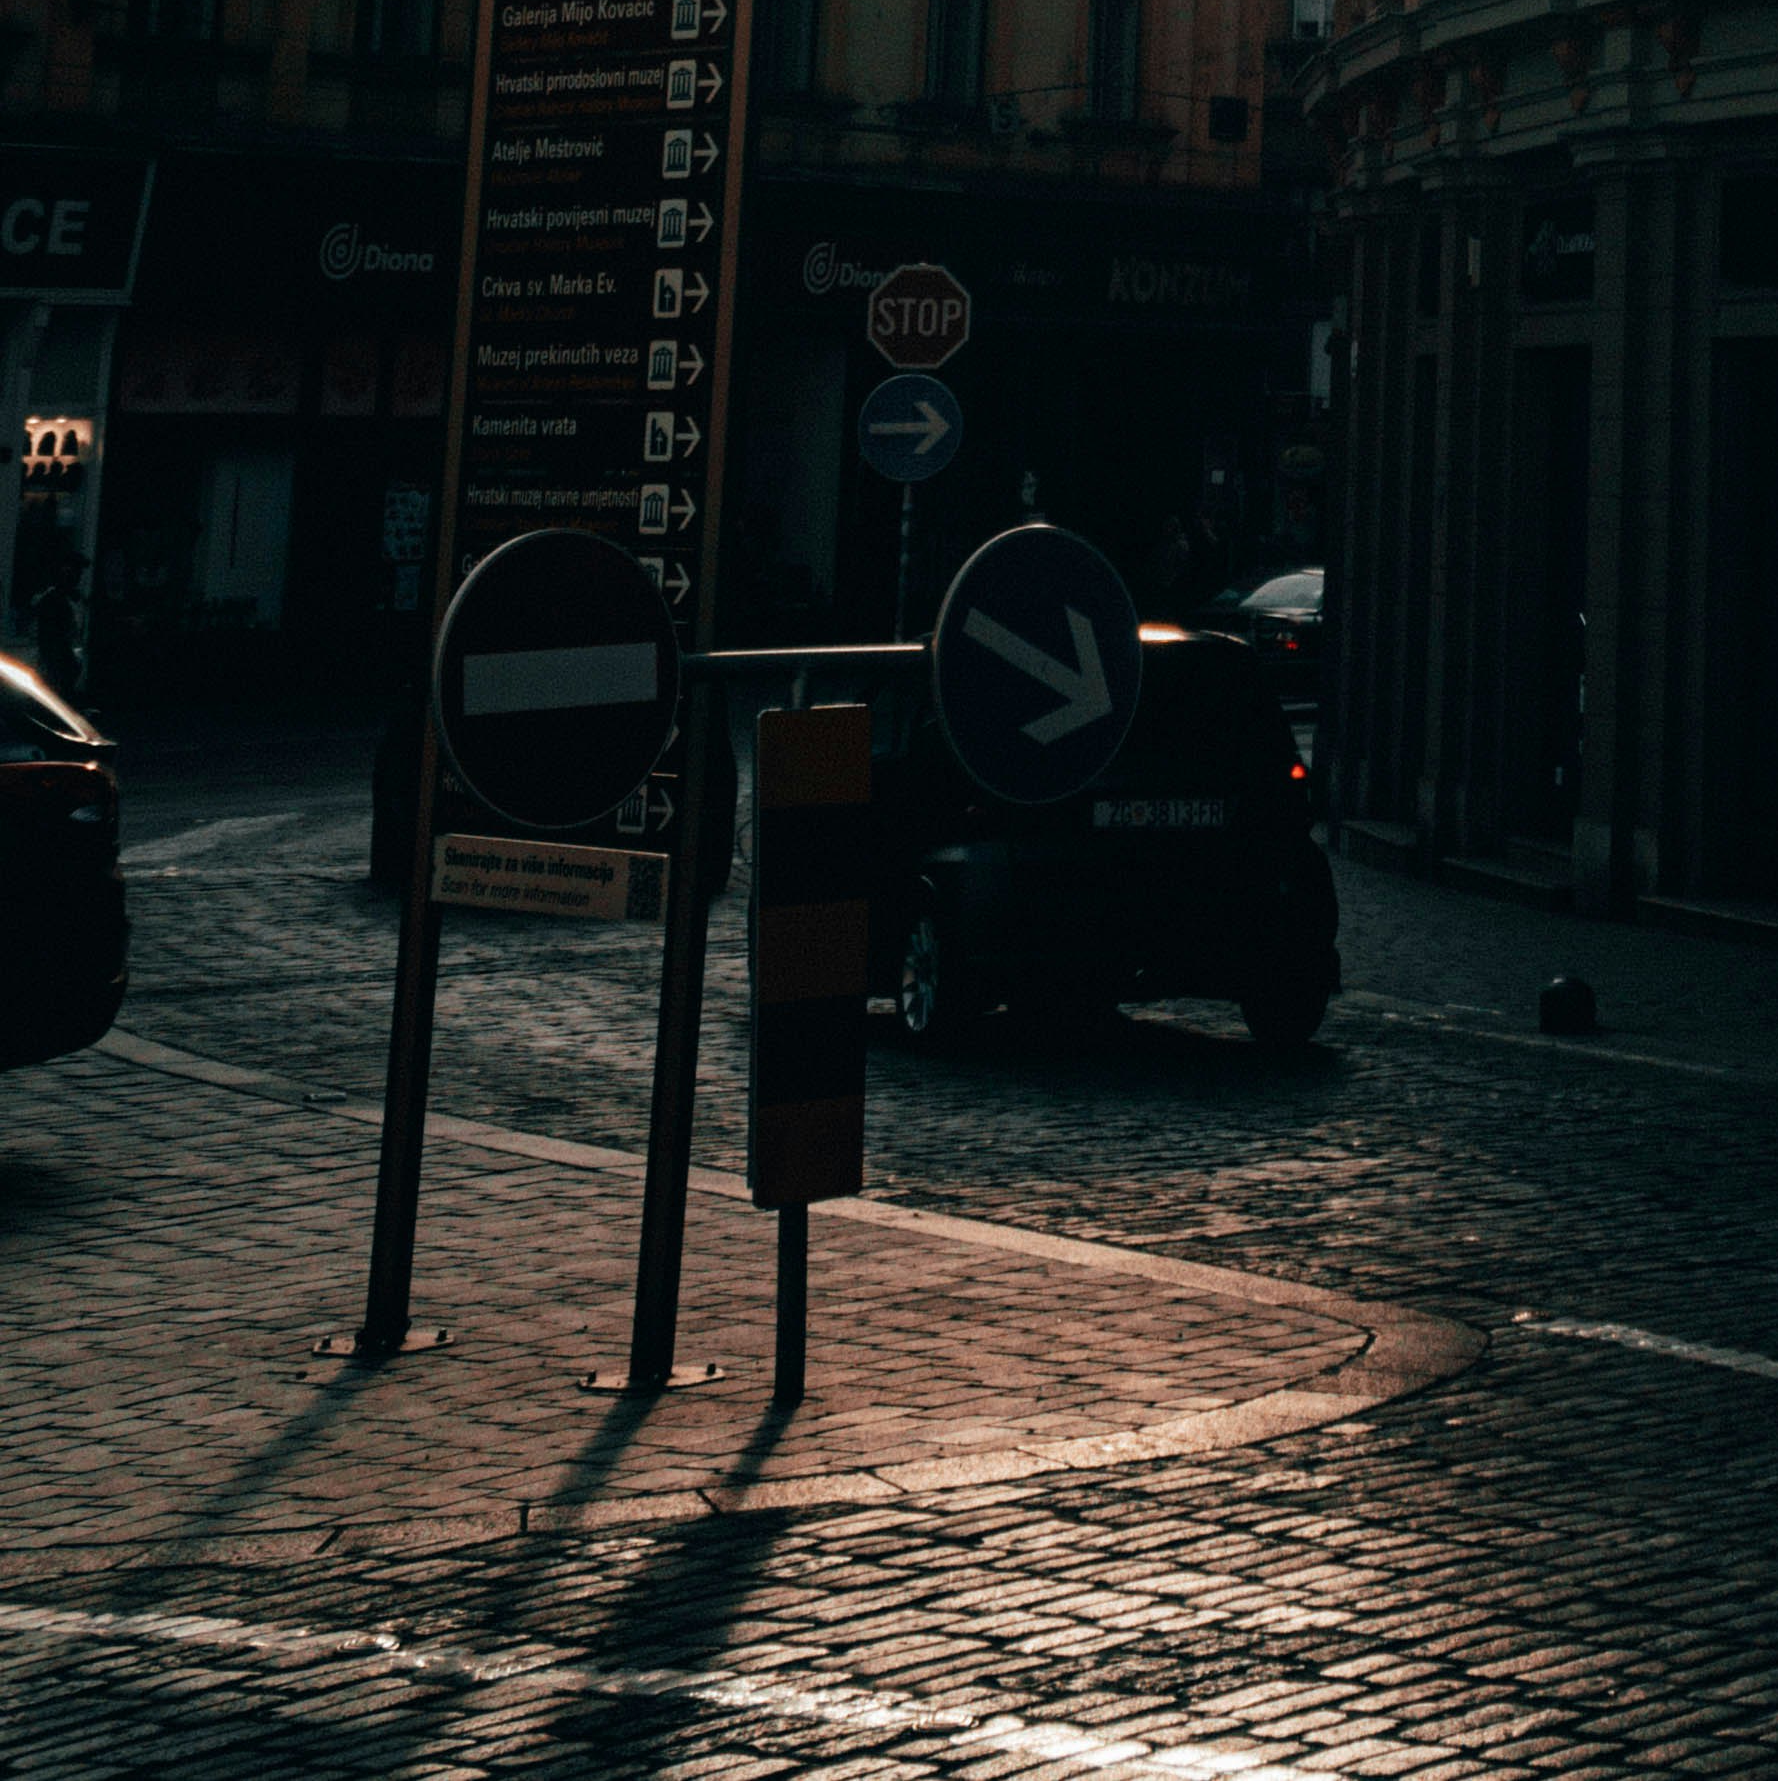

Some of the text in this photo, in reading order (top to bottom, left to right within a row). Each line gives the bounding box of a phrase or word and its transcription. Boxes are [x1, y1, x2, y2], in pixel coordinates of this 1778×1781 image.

[502, 5, 558, 28] Galerija
[560, 2, 593, 26] Mijo
[495, 63, 665, 96] Hrvatski prirodoslovni muzej
[491, 141, 531, 165] Atelje
[486, 200, 657, 231] Hrvatski povijesni muzej
[481, 275, 521, 298] Crkva
[549, 273, 593, 295] Marka
[596, 271, 617, 294] Ev.
[877, 297, 962, 337] STOP
[476, 344, 640, 370] Muzej prekinutih veza
[471, 414, 577, 437] Kamenita vrata
[467, 483, 640, 511] Hrvatski muzej naivne umjetnosti
[442, 875, 590, 907] Scan for more information
